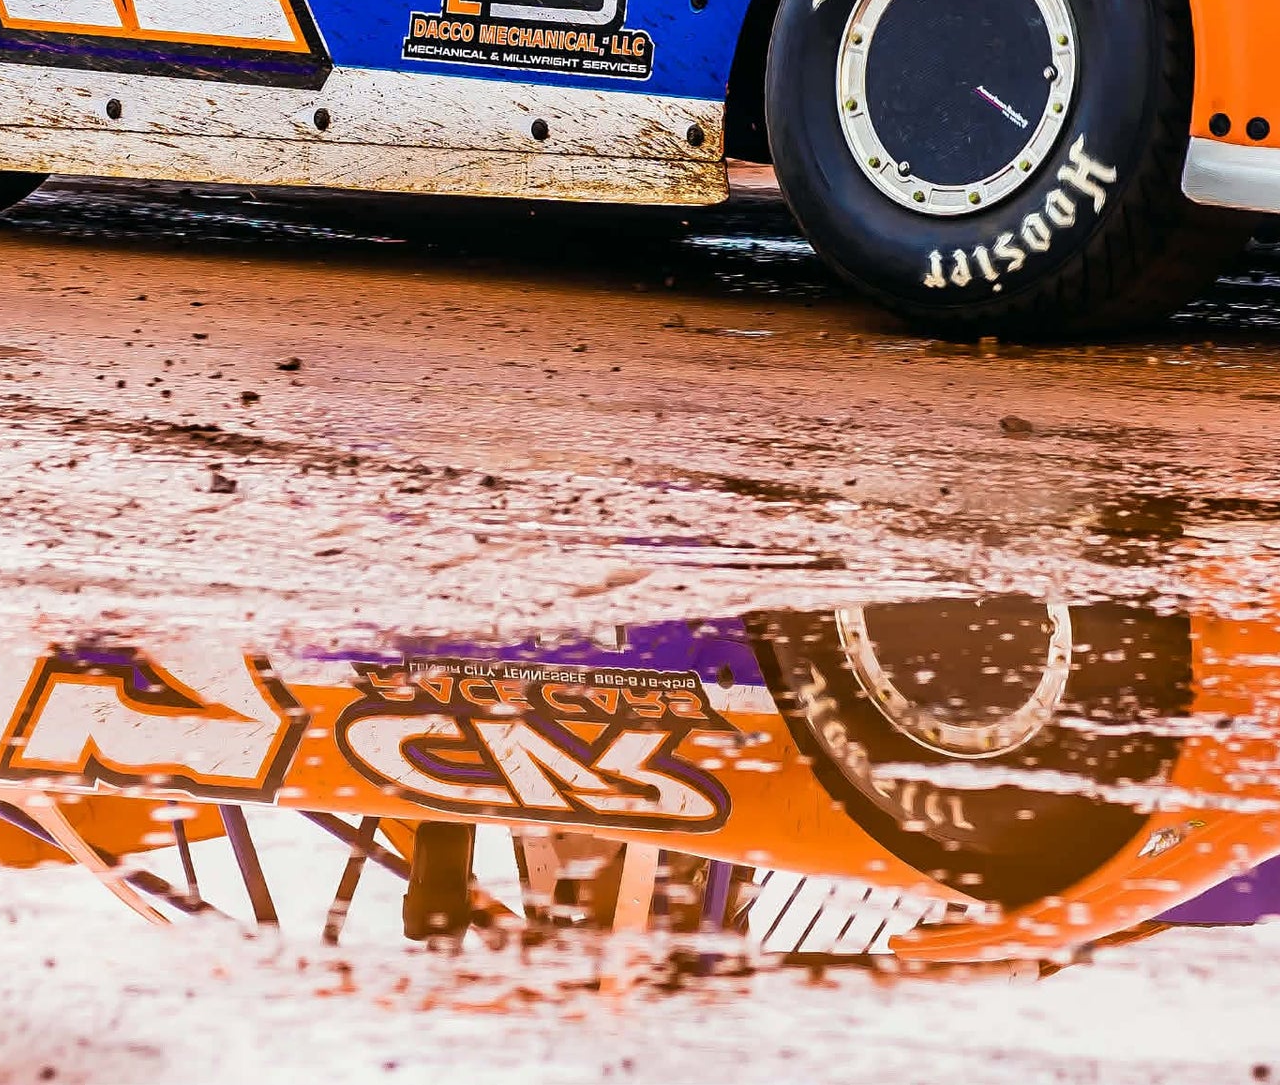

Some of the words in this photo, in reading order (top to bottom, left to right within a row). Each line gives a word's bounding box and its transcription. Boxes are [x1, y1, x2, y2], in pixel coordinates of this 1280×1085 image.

[413, 18, 475, 42] DACCO
[610, 34, 646, 57] LLC
[407, 43, 487, 60] MECHANICAL
[489, 52, 500, 62] &
[502, 53, 581, 69] MILLWRIGHT
[581, 59, 647, 74] SERVICES
[923, 133, 1118, 293] Hoosier
